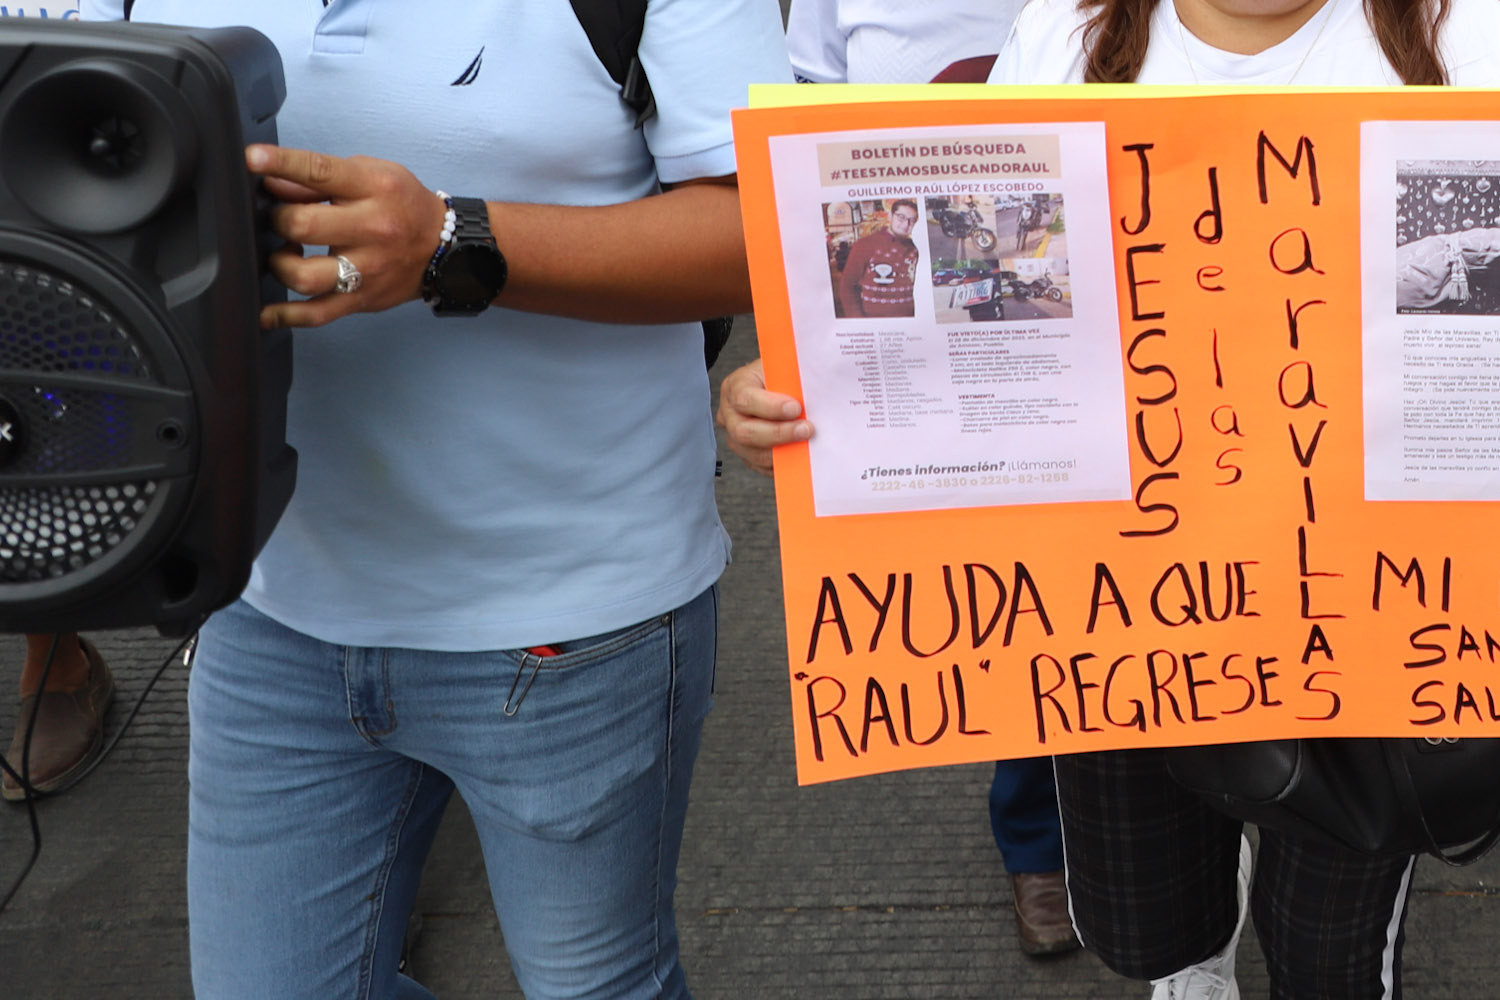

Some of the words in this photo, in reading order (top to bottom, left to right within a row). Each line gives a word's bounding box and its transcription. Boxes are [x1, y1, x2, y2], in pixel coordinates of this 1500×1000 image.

[851, 143, 917, 161] BOLETÍN
[919, 144, 940, 157] DE
[944, 141, 1027, 156] BÚSQUEDA
[830, 162, 1050, 181] #TEESTAMOSBUSCANDORAUL
[847, 186, 913, 198] GUILLERMO
[914, 183, 945, 195] RAÚL
[946, 182, 981, 193] LÓPEZ
[982, 182, 1045, 194] ESCOBEDO
[861, 465, 913, 480] ¿Tienes
[914, 461, 1006, 476] información?
[807, 562, 1054, 664] AYUDA
[1086, 562, 1132, 634] A
[1150, 560, 1262, 627] QUE
[1372, 551, 1451, 613] MI
[1030, 650, 1283, 745] REGRESE
